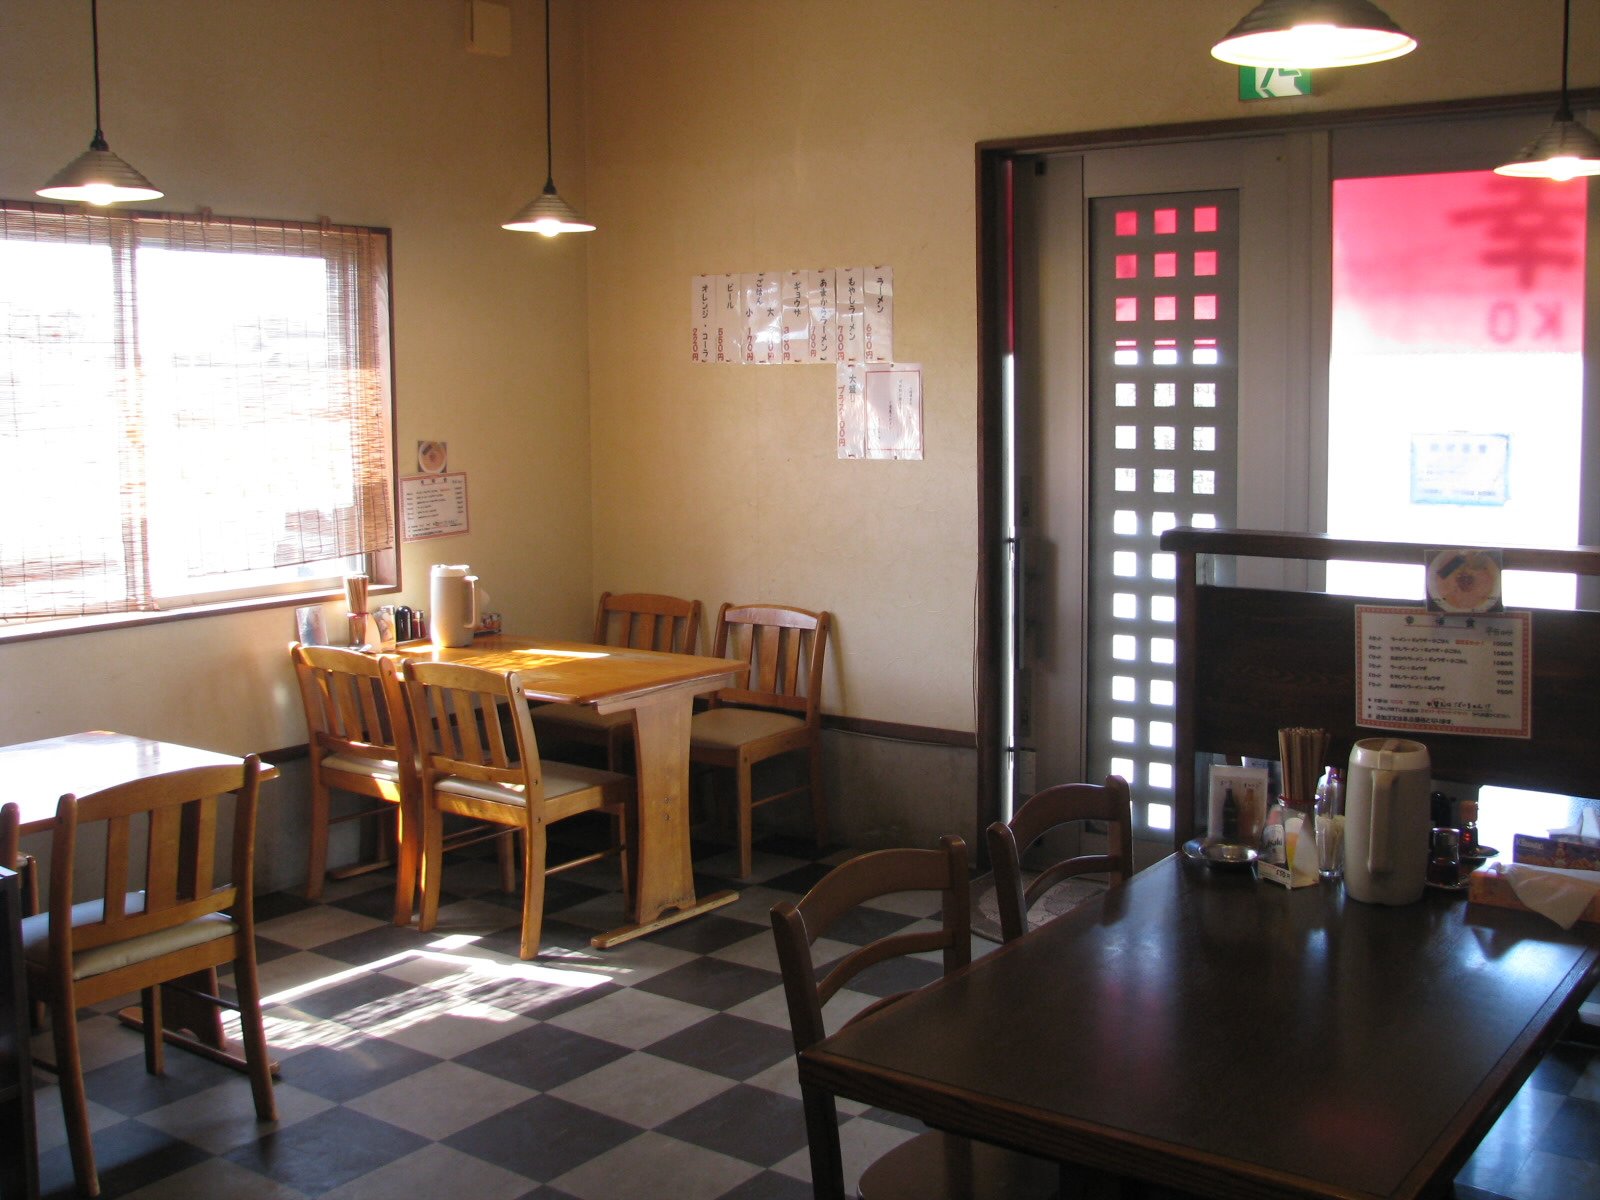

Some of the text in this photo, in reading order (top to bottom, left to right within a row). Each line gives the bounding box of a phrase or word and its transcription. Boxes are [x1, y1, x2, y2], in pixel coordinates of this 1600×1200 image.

[726, 283, 734, 309] ビール
[848, 277, 856, 341] もやしラーメン
[876, 277, 884, 313] ラーメン
[717, 327, 725, 361] 550円
[865, 323, 873, 359] 650円
